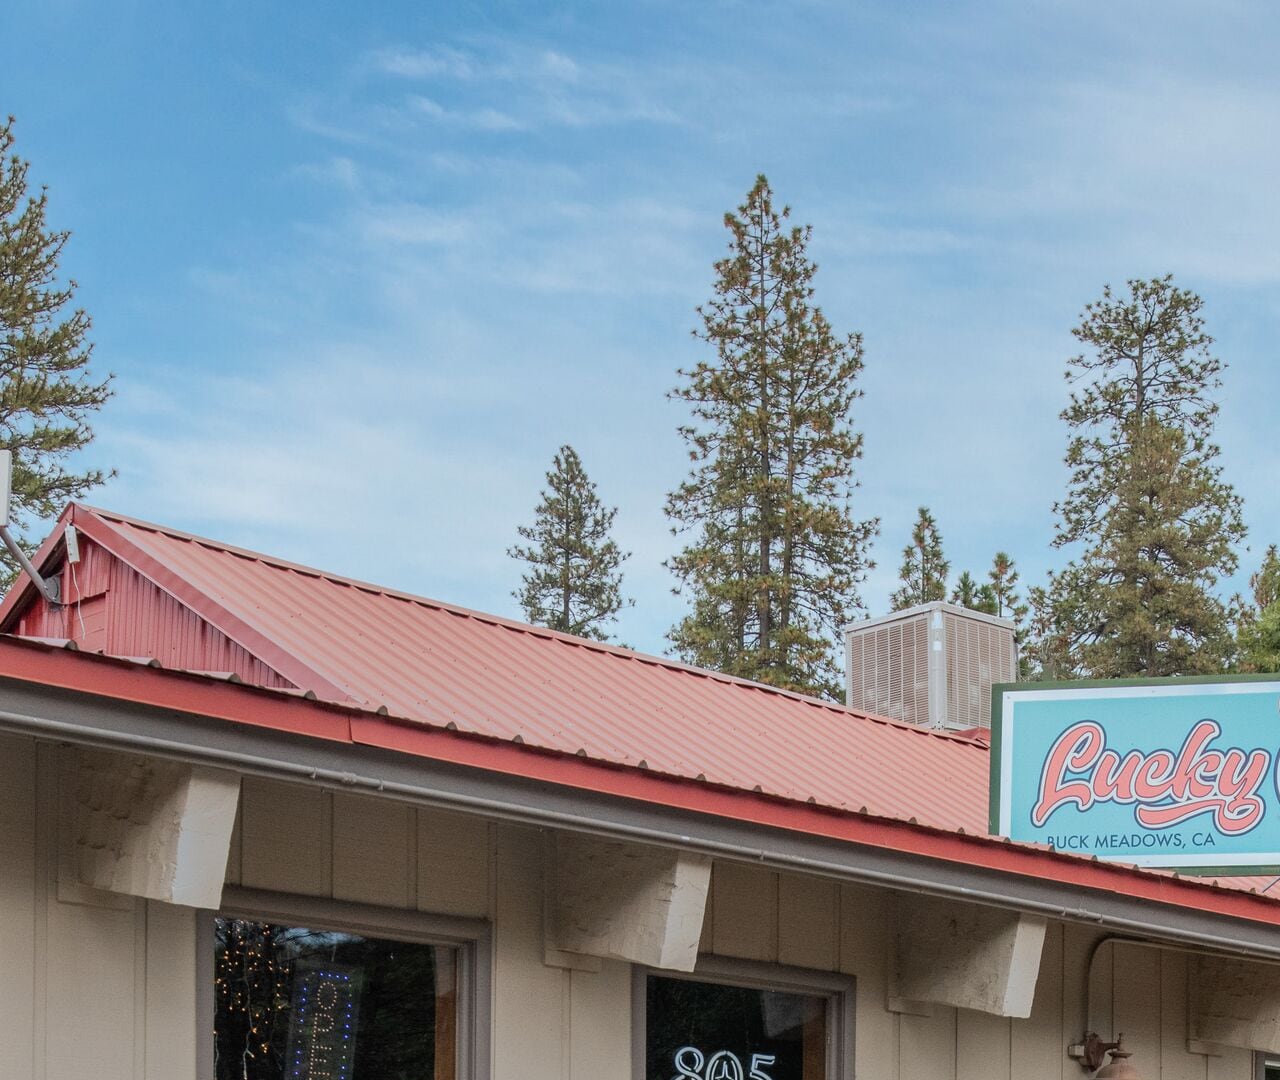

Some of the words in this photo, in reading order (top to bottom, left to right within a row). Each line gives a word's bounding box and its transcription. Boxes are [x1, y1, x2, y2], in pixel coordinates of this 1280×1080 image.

[1031, 718, 1271, 836] Lucky
[1047, 835, 1089, 849] BUCK
[1095, 833, 1186, 849] MEADOWS,
[1192, 832, 1216, 847] CA
